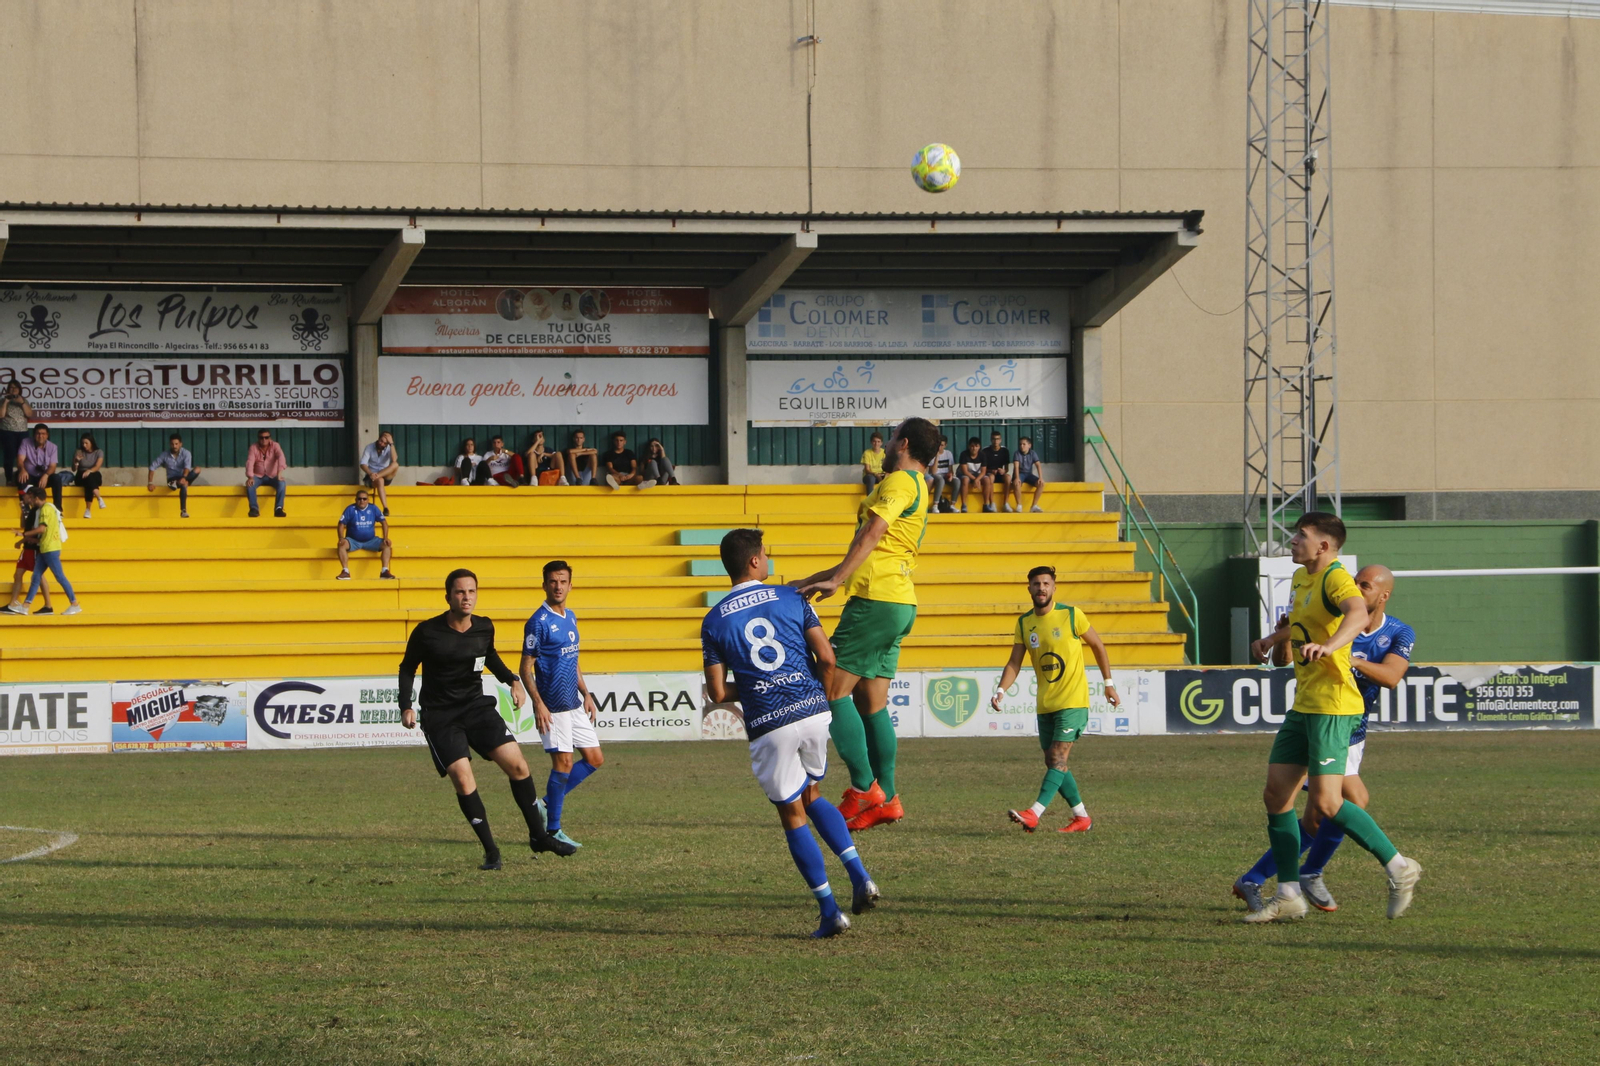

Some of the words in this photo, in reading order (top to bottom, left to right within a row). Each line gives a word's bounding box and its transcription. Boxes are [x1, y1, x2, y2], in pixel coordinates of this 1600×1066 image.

[432, 298, 487, 307] ALBORÁN
[618, 298, 672, 307] ALBORÁN
[816, 295, 864, 307] GRUPO
[978, 294, 1026, 306] GRUPO
[89, 293, 143, 340] Los
[157, 293, 260, 342] Pulpos
[435, 325, 480, 339] Algeciras
[548, 323, 564, 333] TU
[568, 323, 610, 333] LUGAR
[806, 326, 872, 338] DENTAL
[970, 326, 1032, 338] DENTAL
[486, 334, 502, 344] DE
[508, 334, 612, 344] CELEBRACIONES
[88, 342, 108, 350] Playa
[165, 342, 199, 351] Algeciras
[1, 387, 86, 399] AOGADOS
[100, 387, 179, 399] GESTIONES
[192, 387, 261, 399] EMPRESAS
[274, 386, 339, 399] SEGUROS
[406, 376, 466, 396] Buena
[469, 378, 526, 407] gente,
[533, 376, 600, 397] buenas
[602, 382, 679, 405] razones
[74, 401, 102, 410] todos
[105, 401, 151, 410] nuestros
[153, 401, 200, 410] servicios
[275, 401, 312, 409] Turrillo
[779, 397, 887, 410] EQUILIBRIUM
[922, 395, 1029, 409] EQUILIBRIUM
[744, 617, 786, 671] 8
[1531, 672, 1568, 687] Integral
[360, 689, 417, 704] ELECTO
[1476, 686, 1494, 698] 956
[1496, 686, 1514, 698] 650
[1516, 686, 1533, 698] 353
[126, 689, 188, 727] MIGUEL
[1476, 699, 1579, 712] info@clementecg.com
[750, 714, 773, 728] XEREZ
[773, 698, 816, 719] DEPORTIVO
[1476, 712, 1507, 721] Clemente
[1508, 712, 1529, 721] Centro
[619, 716, 690, 727] Eléctricos
